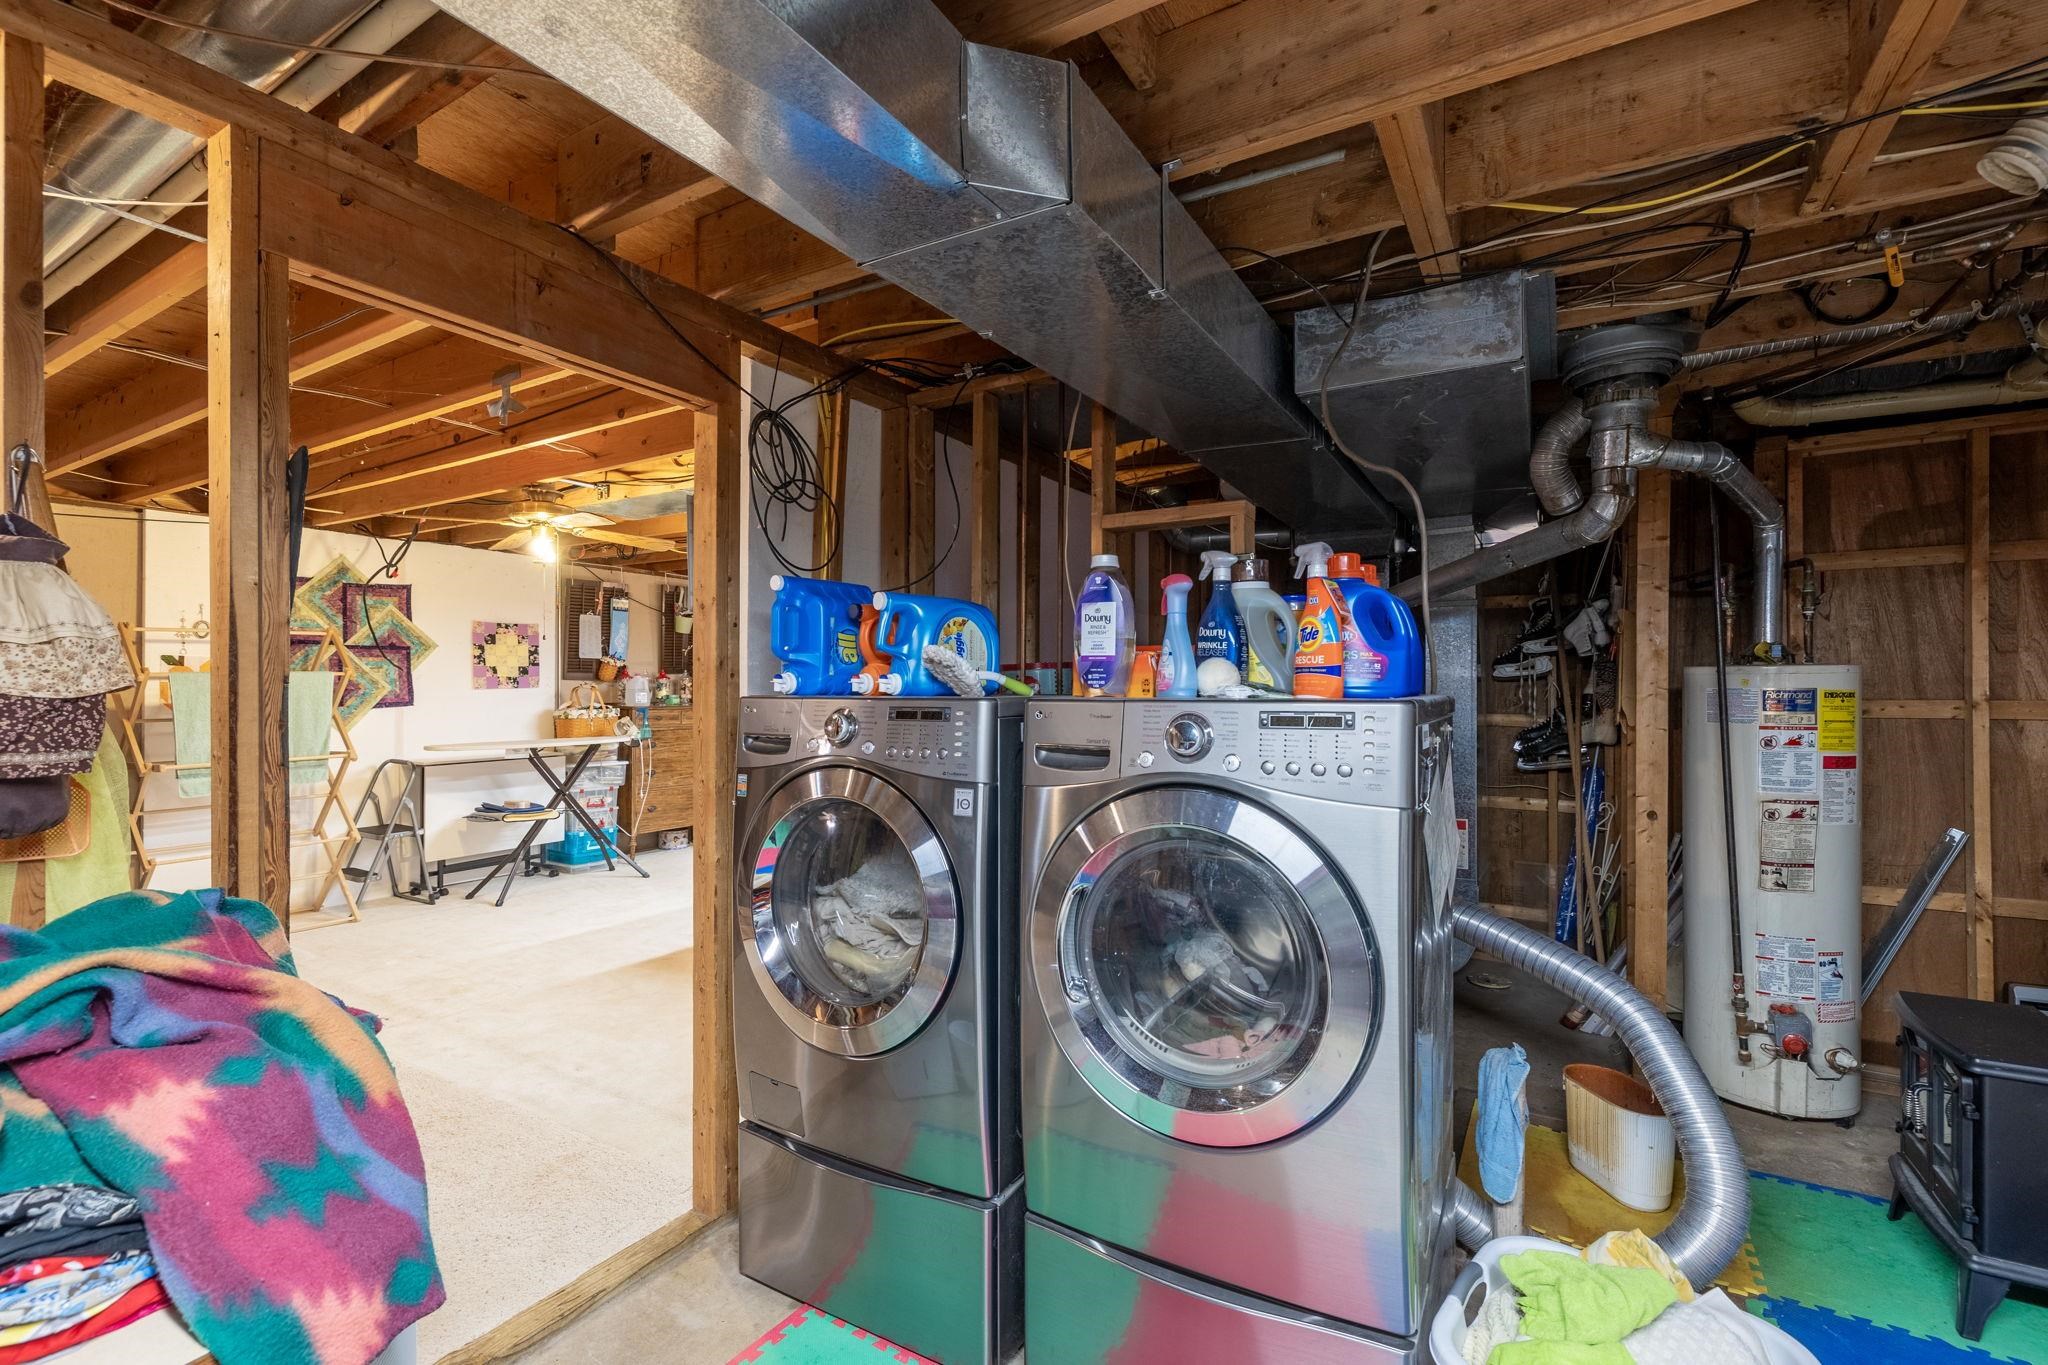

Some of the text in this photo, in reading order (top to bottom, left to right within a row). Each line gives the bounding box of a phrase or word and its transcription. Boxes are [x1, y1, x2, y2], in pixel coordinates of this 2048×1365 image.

[1084, 613, 1112, 625] Downy
[1199, 626, 1227, 640] Downy
[1299, 626, 1320, 644] Tide
[1197, 641, 1228, 649] WRINKLE
[1295, 655, 1325, 664] RESCUE
[1765, 690, 1813, 699] Richmond
